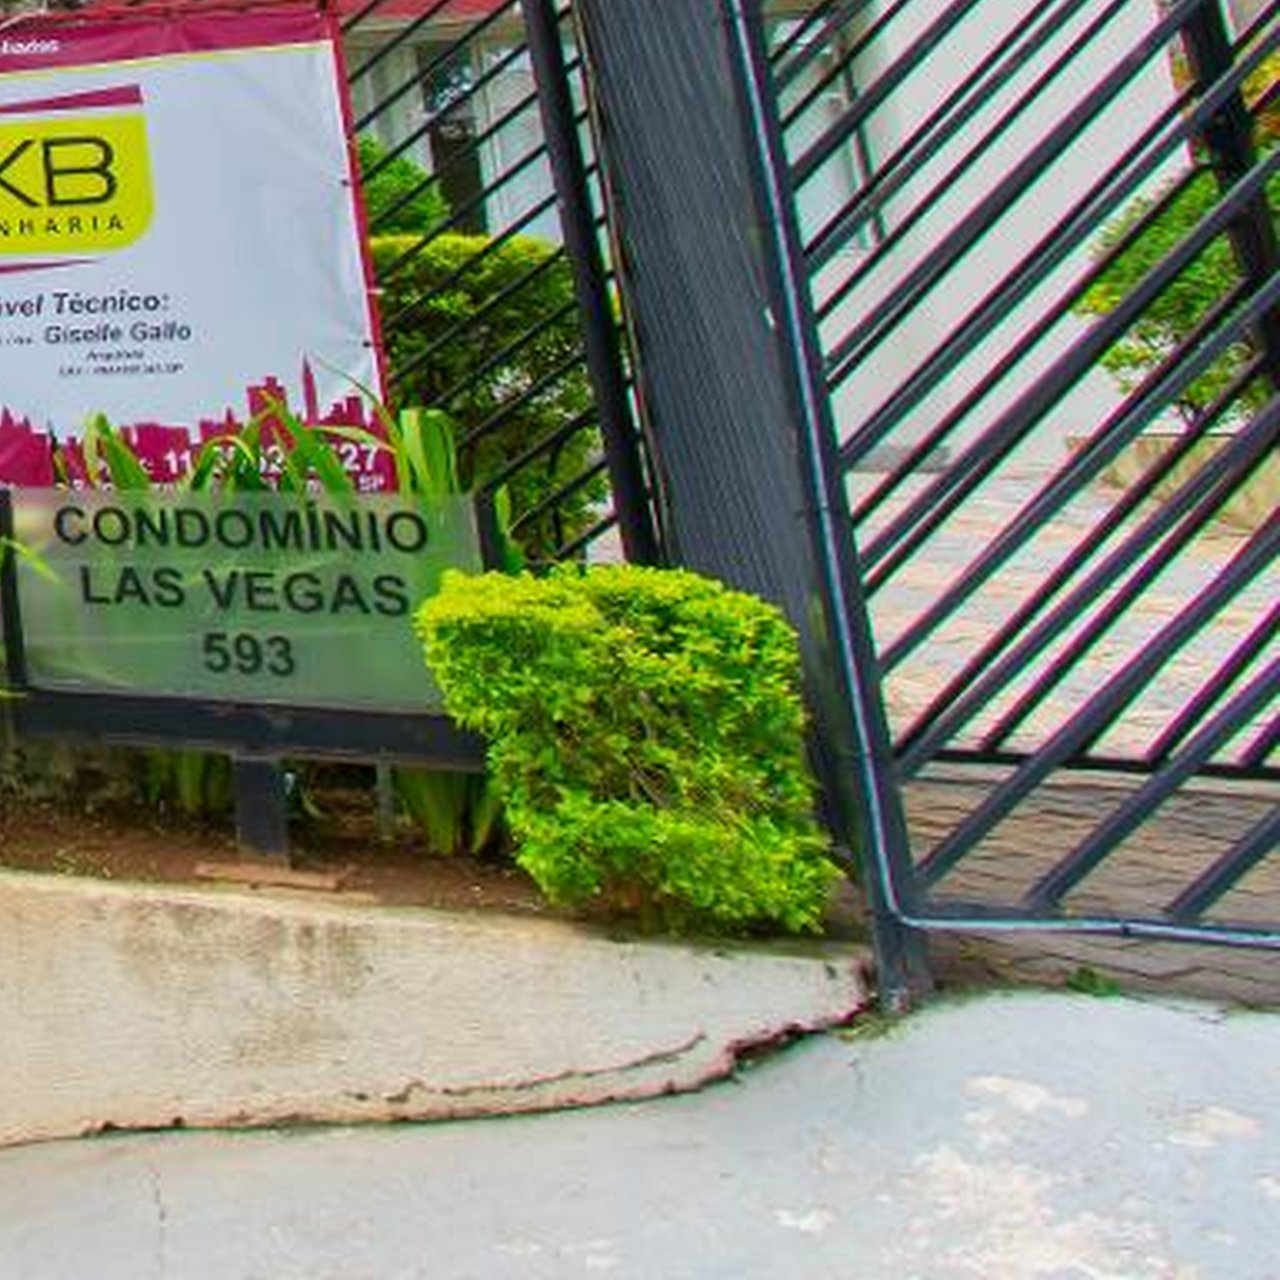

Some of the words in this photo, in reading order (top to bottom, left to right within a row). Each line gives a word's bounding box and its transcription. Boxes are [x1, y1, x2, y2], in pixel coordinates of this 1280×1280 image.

[52, 289, 170, 314] Técnico:
[54, 501, 428, 553] CONDOMÍNIO
[80, 565, 185, 607] LAS
[203, 569, 410, 617] VEGAS
[203, 632, 296, 676] 593
